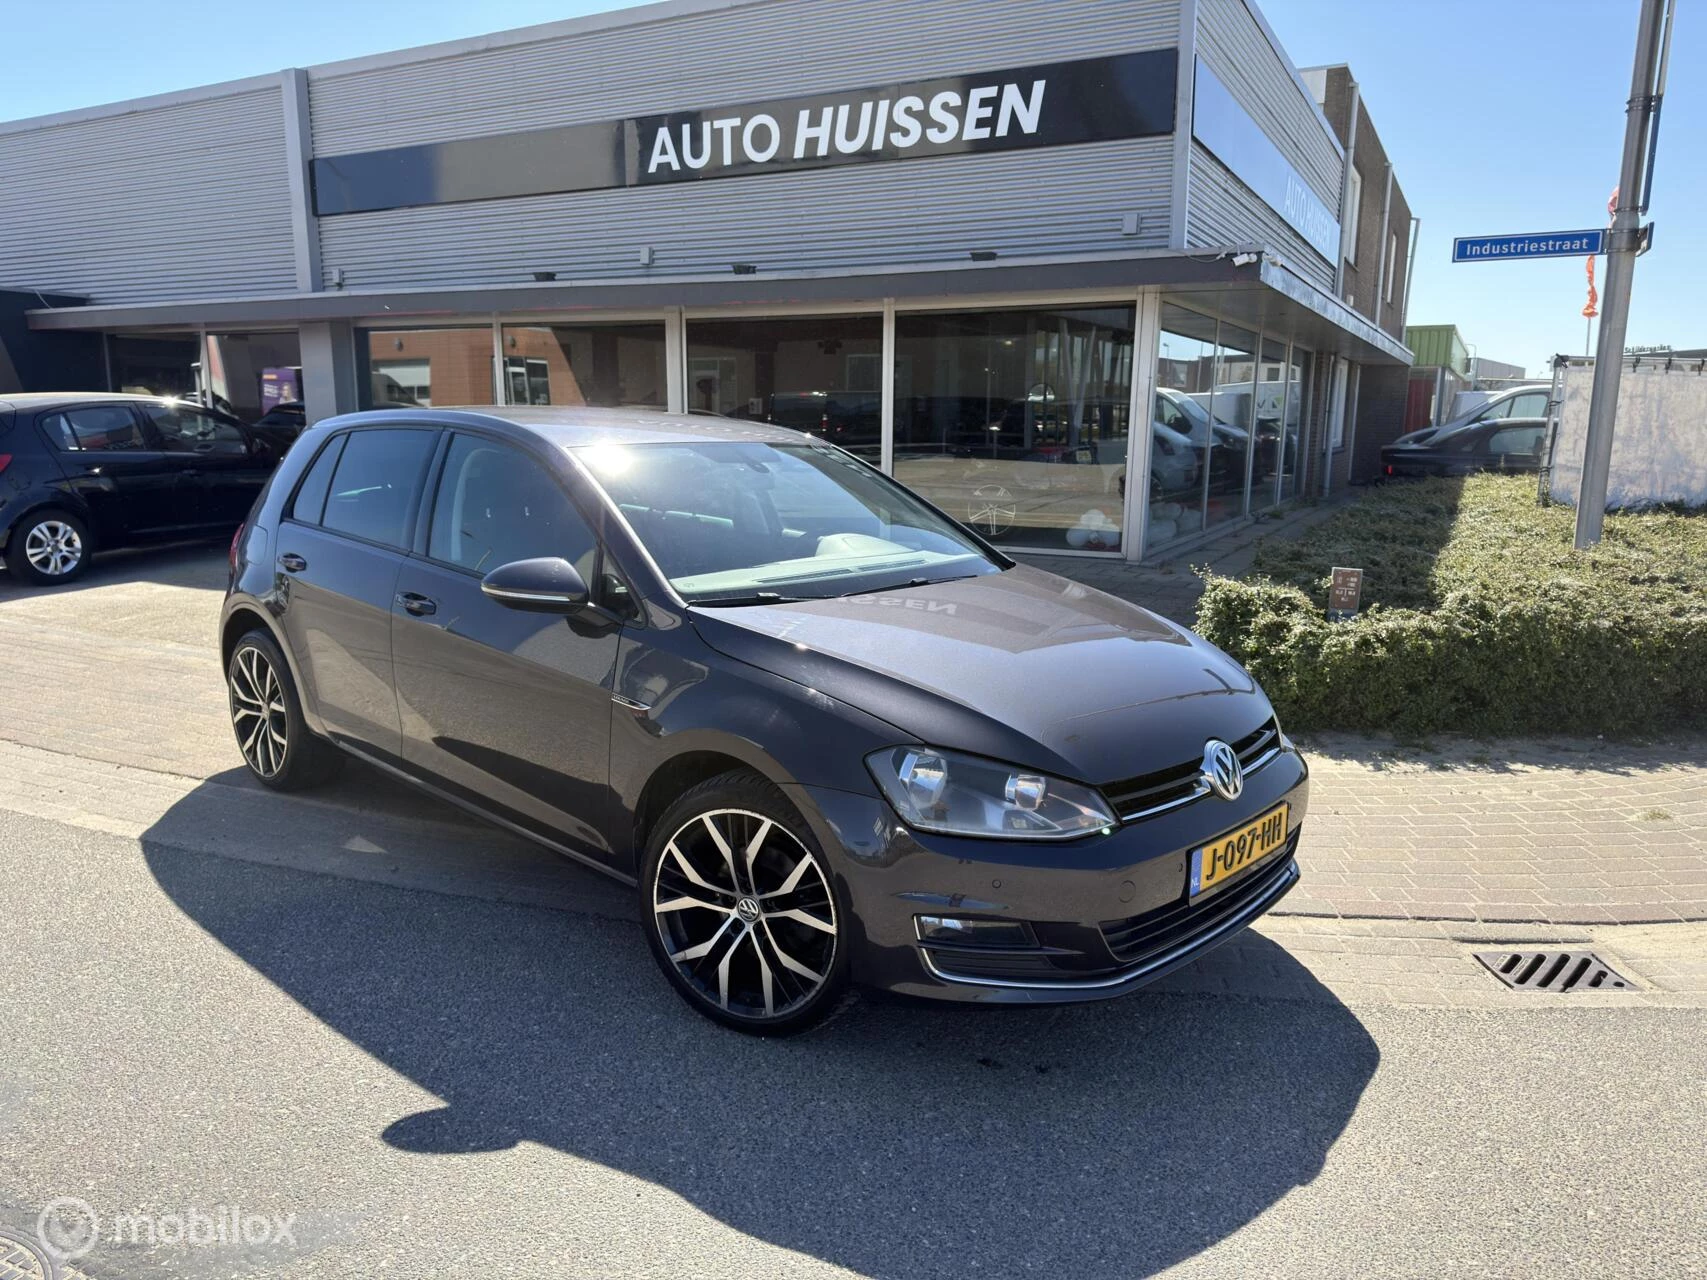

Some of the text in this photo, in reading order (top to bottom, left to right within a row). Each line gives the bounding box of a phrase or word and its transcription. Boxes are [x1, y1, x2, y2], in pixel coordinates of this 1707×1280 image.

[648, 79, 1046, 173] AUTO HUISSEN
[1284, 175, 1306, 228] AUTO
[1466, 237, 1589, 256] Industriestraat
[1206, 812, 1282, 881] J-097-HH
